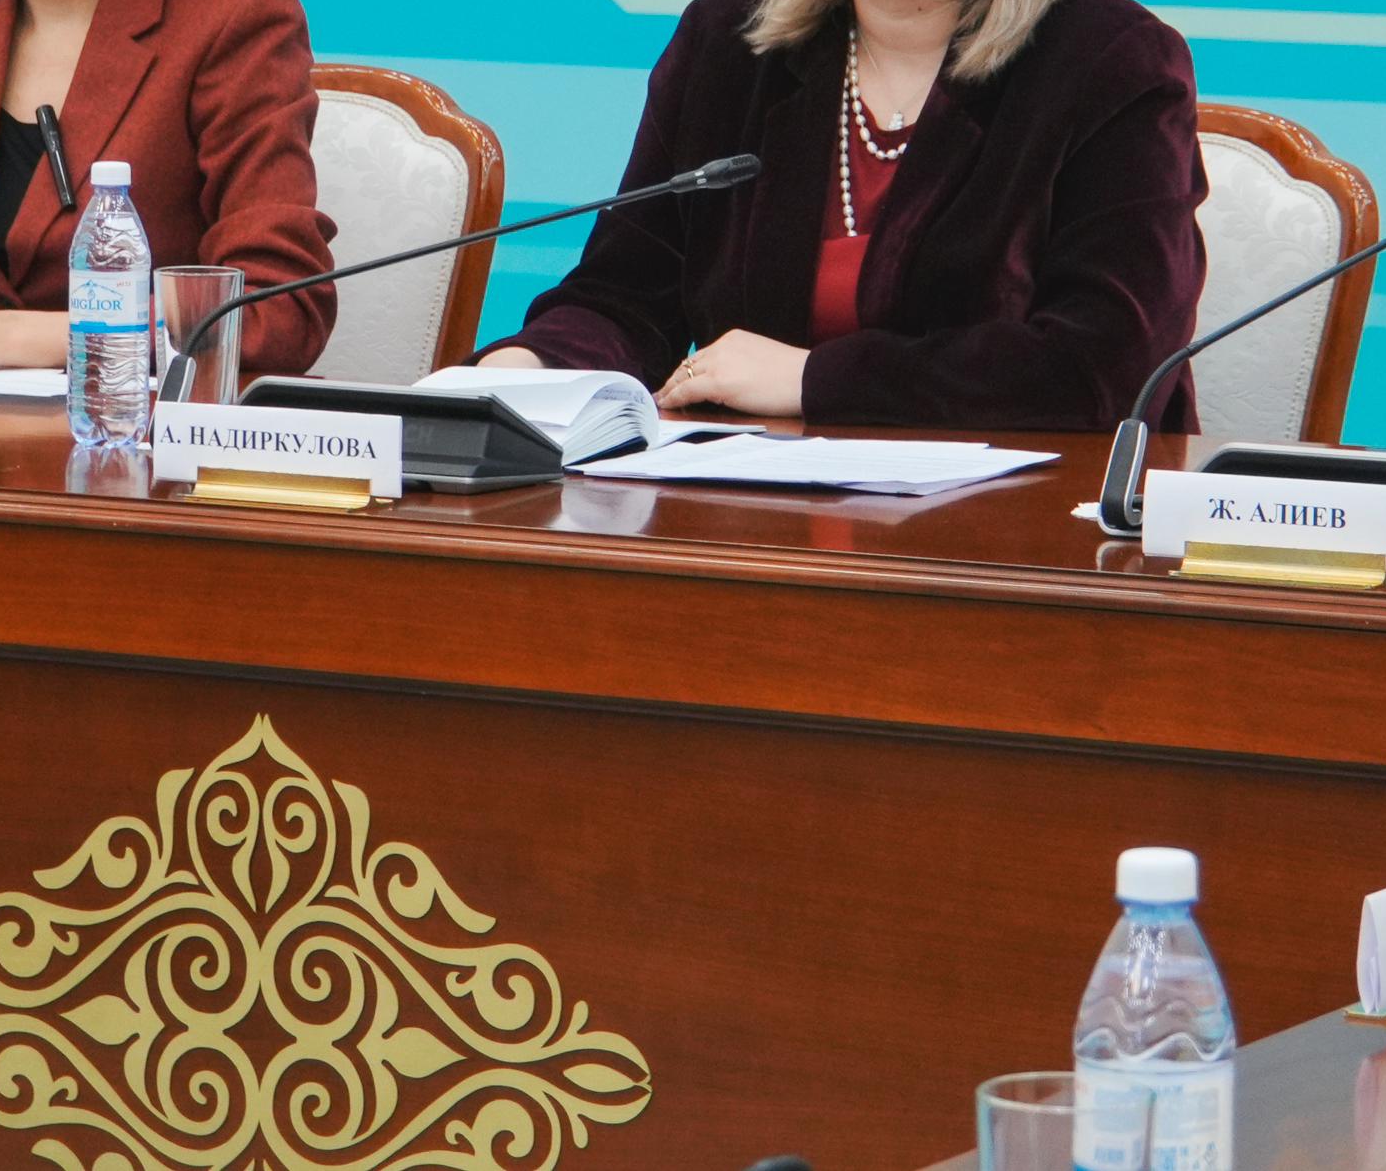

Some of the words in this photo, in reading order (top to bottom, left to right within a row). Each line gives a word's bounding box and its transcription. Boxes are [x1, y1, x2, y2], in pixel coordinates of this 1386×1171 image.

[160, 424, 182, 445] А.
[189, 425, 377, 460] НАДИРКУЛОВА
[1208, 498, 1241, 521] Ж.
[1249, 502, 1347, 529] АЛИЕВ
